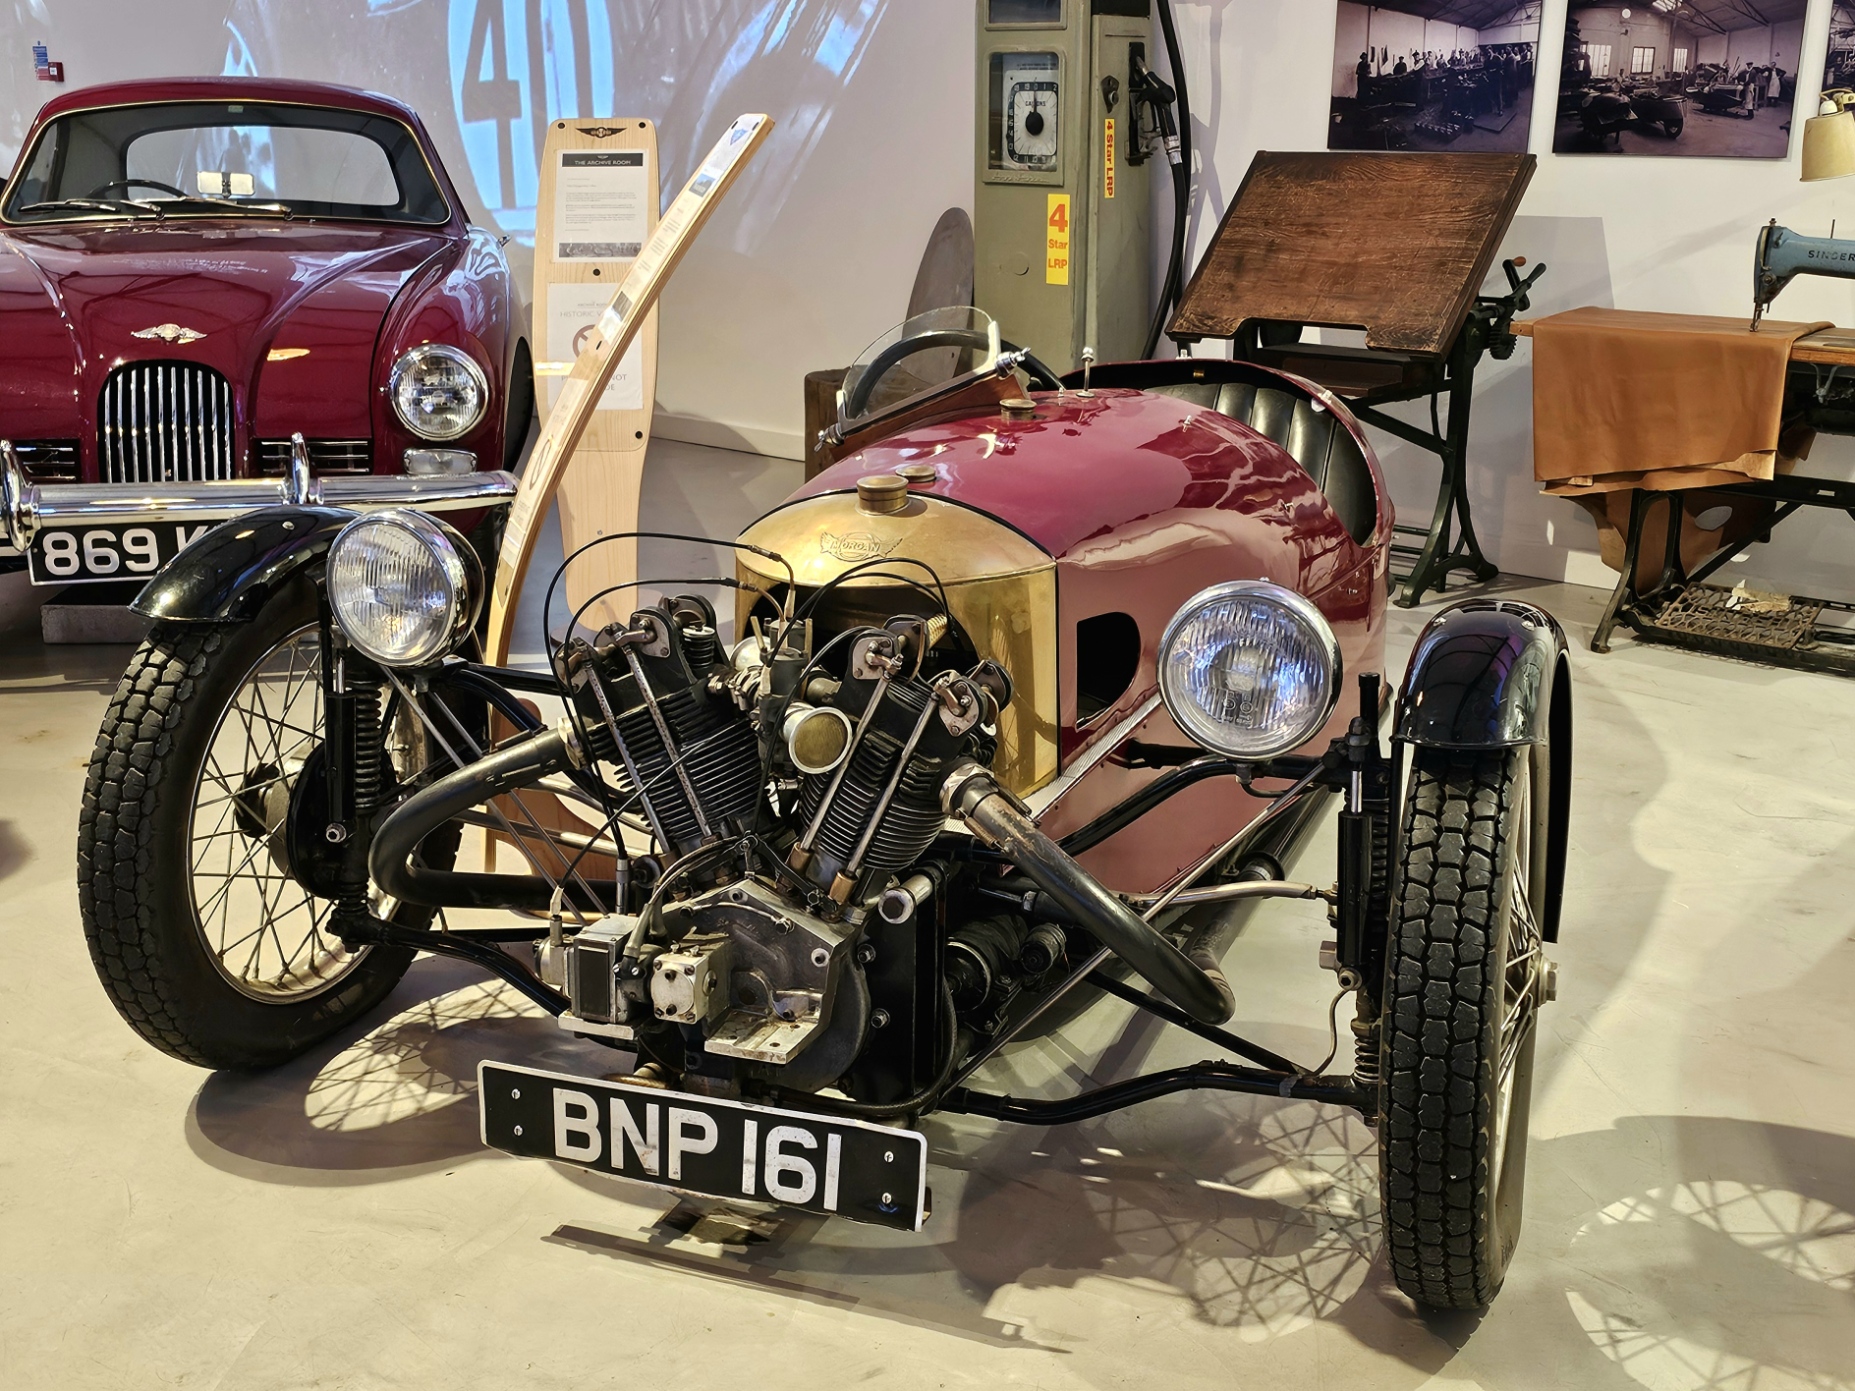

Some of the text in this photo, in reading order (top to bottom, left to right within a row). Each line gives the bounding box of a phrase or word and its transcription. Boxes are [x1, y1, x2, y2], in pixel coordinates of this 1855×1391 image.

[1106, 121, 1114, 196] 4 Star LRP
[1048, 204, 1068, 233] 4
[1048, 239, 1068, 250] Star
[1048, 259, 1068, 269] LRP
[1808, 250, 1855, 261] SINGER
[42, 528, 159, 576] 869
[830, 541, 881, 553] MORGAN
[552, 1087, 842, 1212] BNP 161
